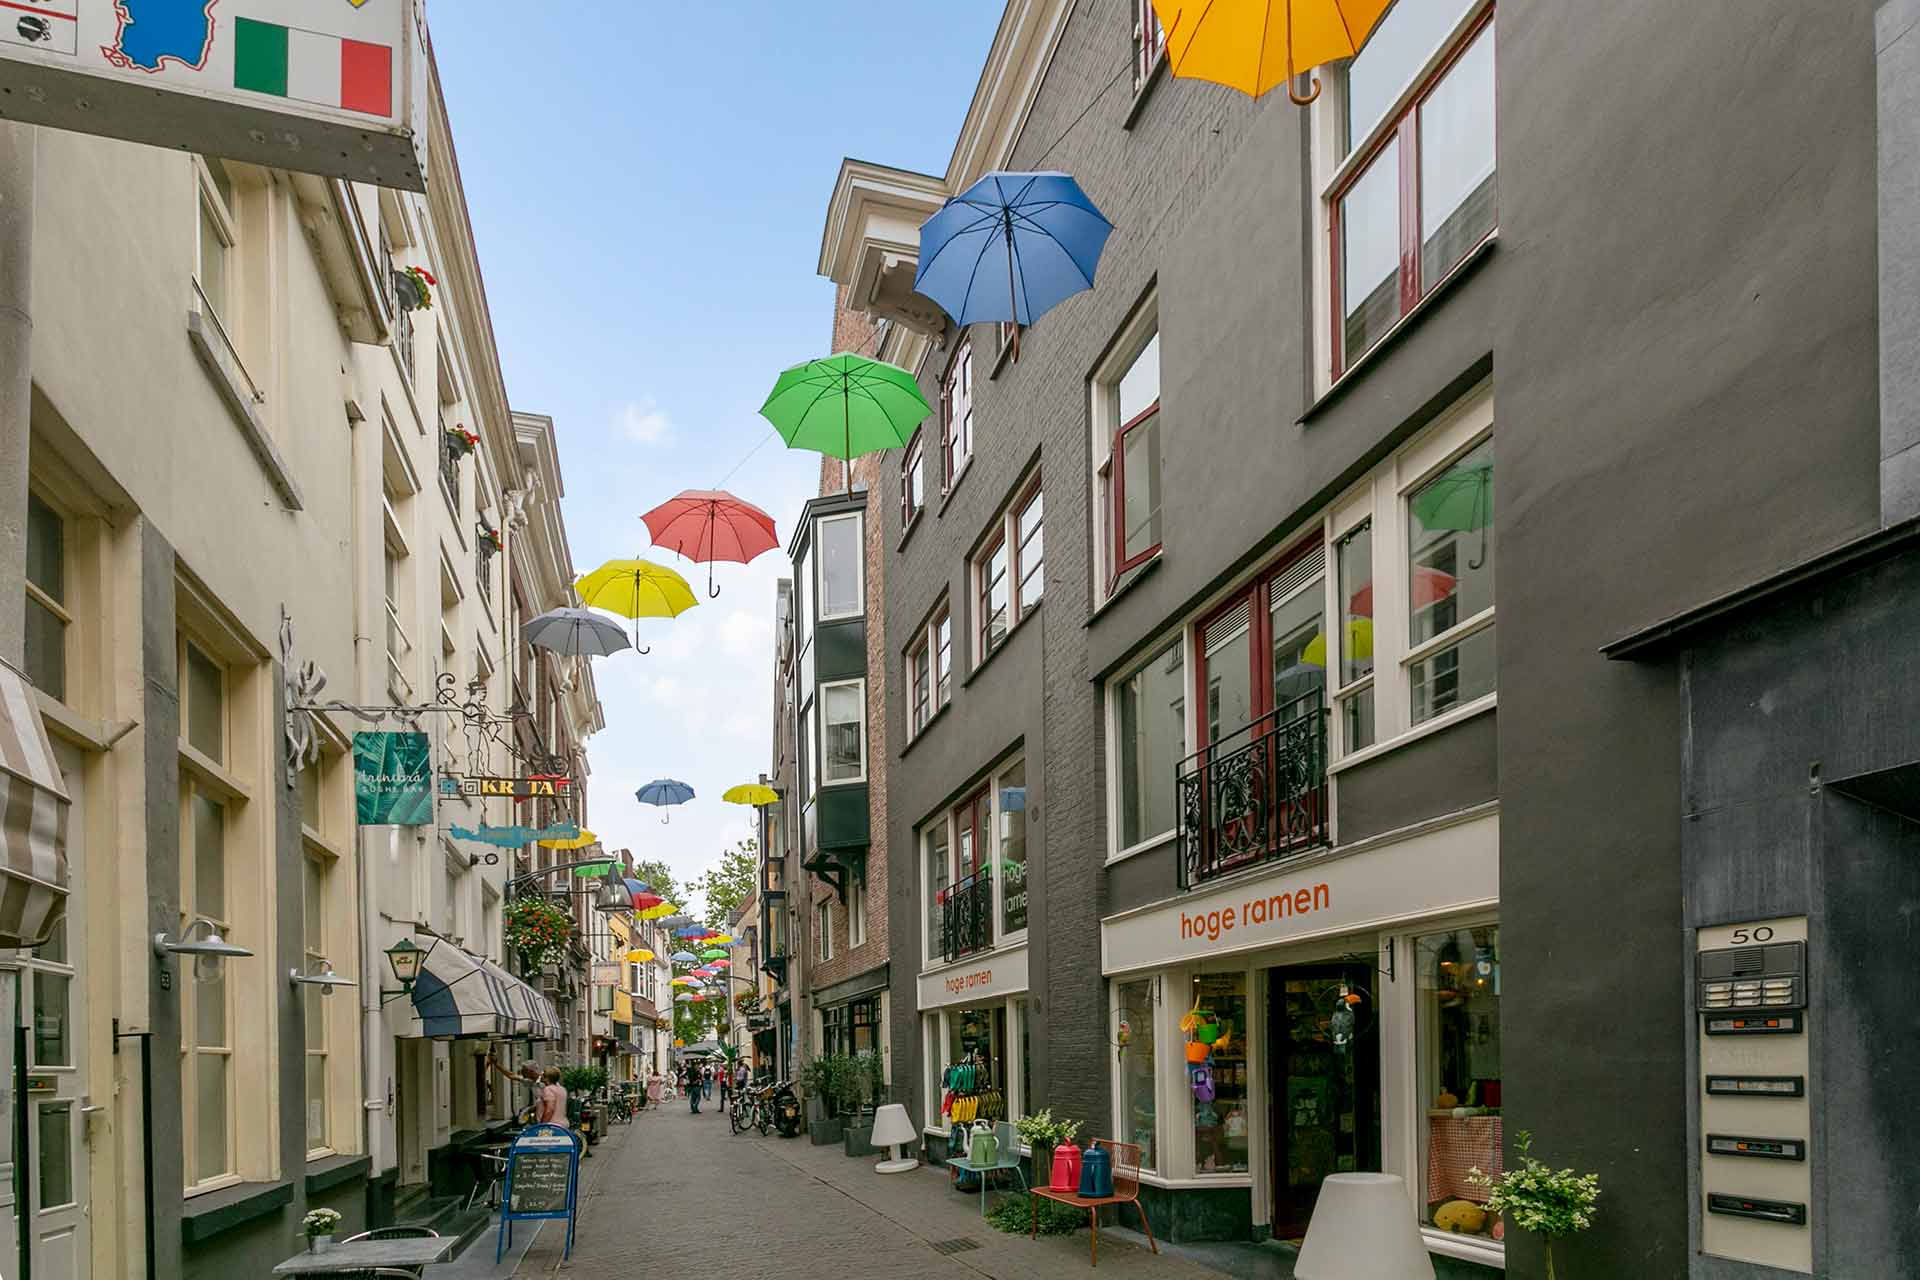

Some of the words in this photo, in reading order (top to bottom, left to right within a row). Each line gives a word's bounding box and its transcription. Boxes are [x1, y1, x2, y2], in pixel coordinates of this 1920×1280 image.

[481, 780, 555, 795] KRTA
[1003, 891, 1028, 913] rame
[1181, 907, 1236, 941] hoge
[1243, 883, 1330, 926] ramen
[1730, 926, 1774, 945] 50
[944, 975, 965, 994] hoge
[965, 969, 993, 988] ramen
